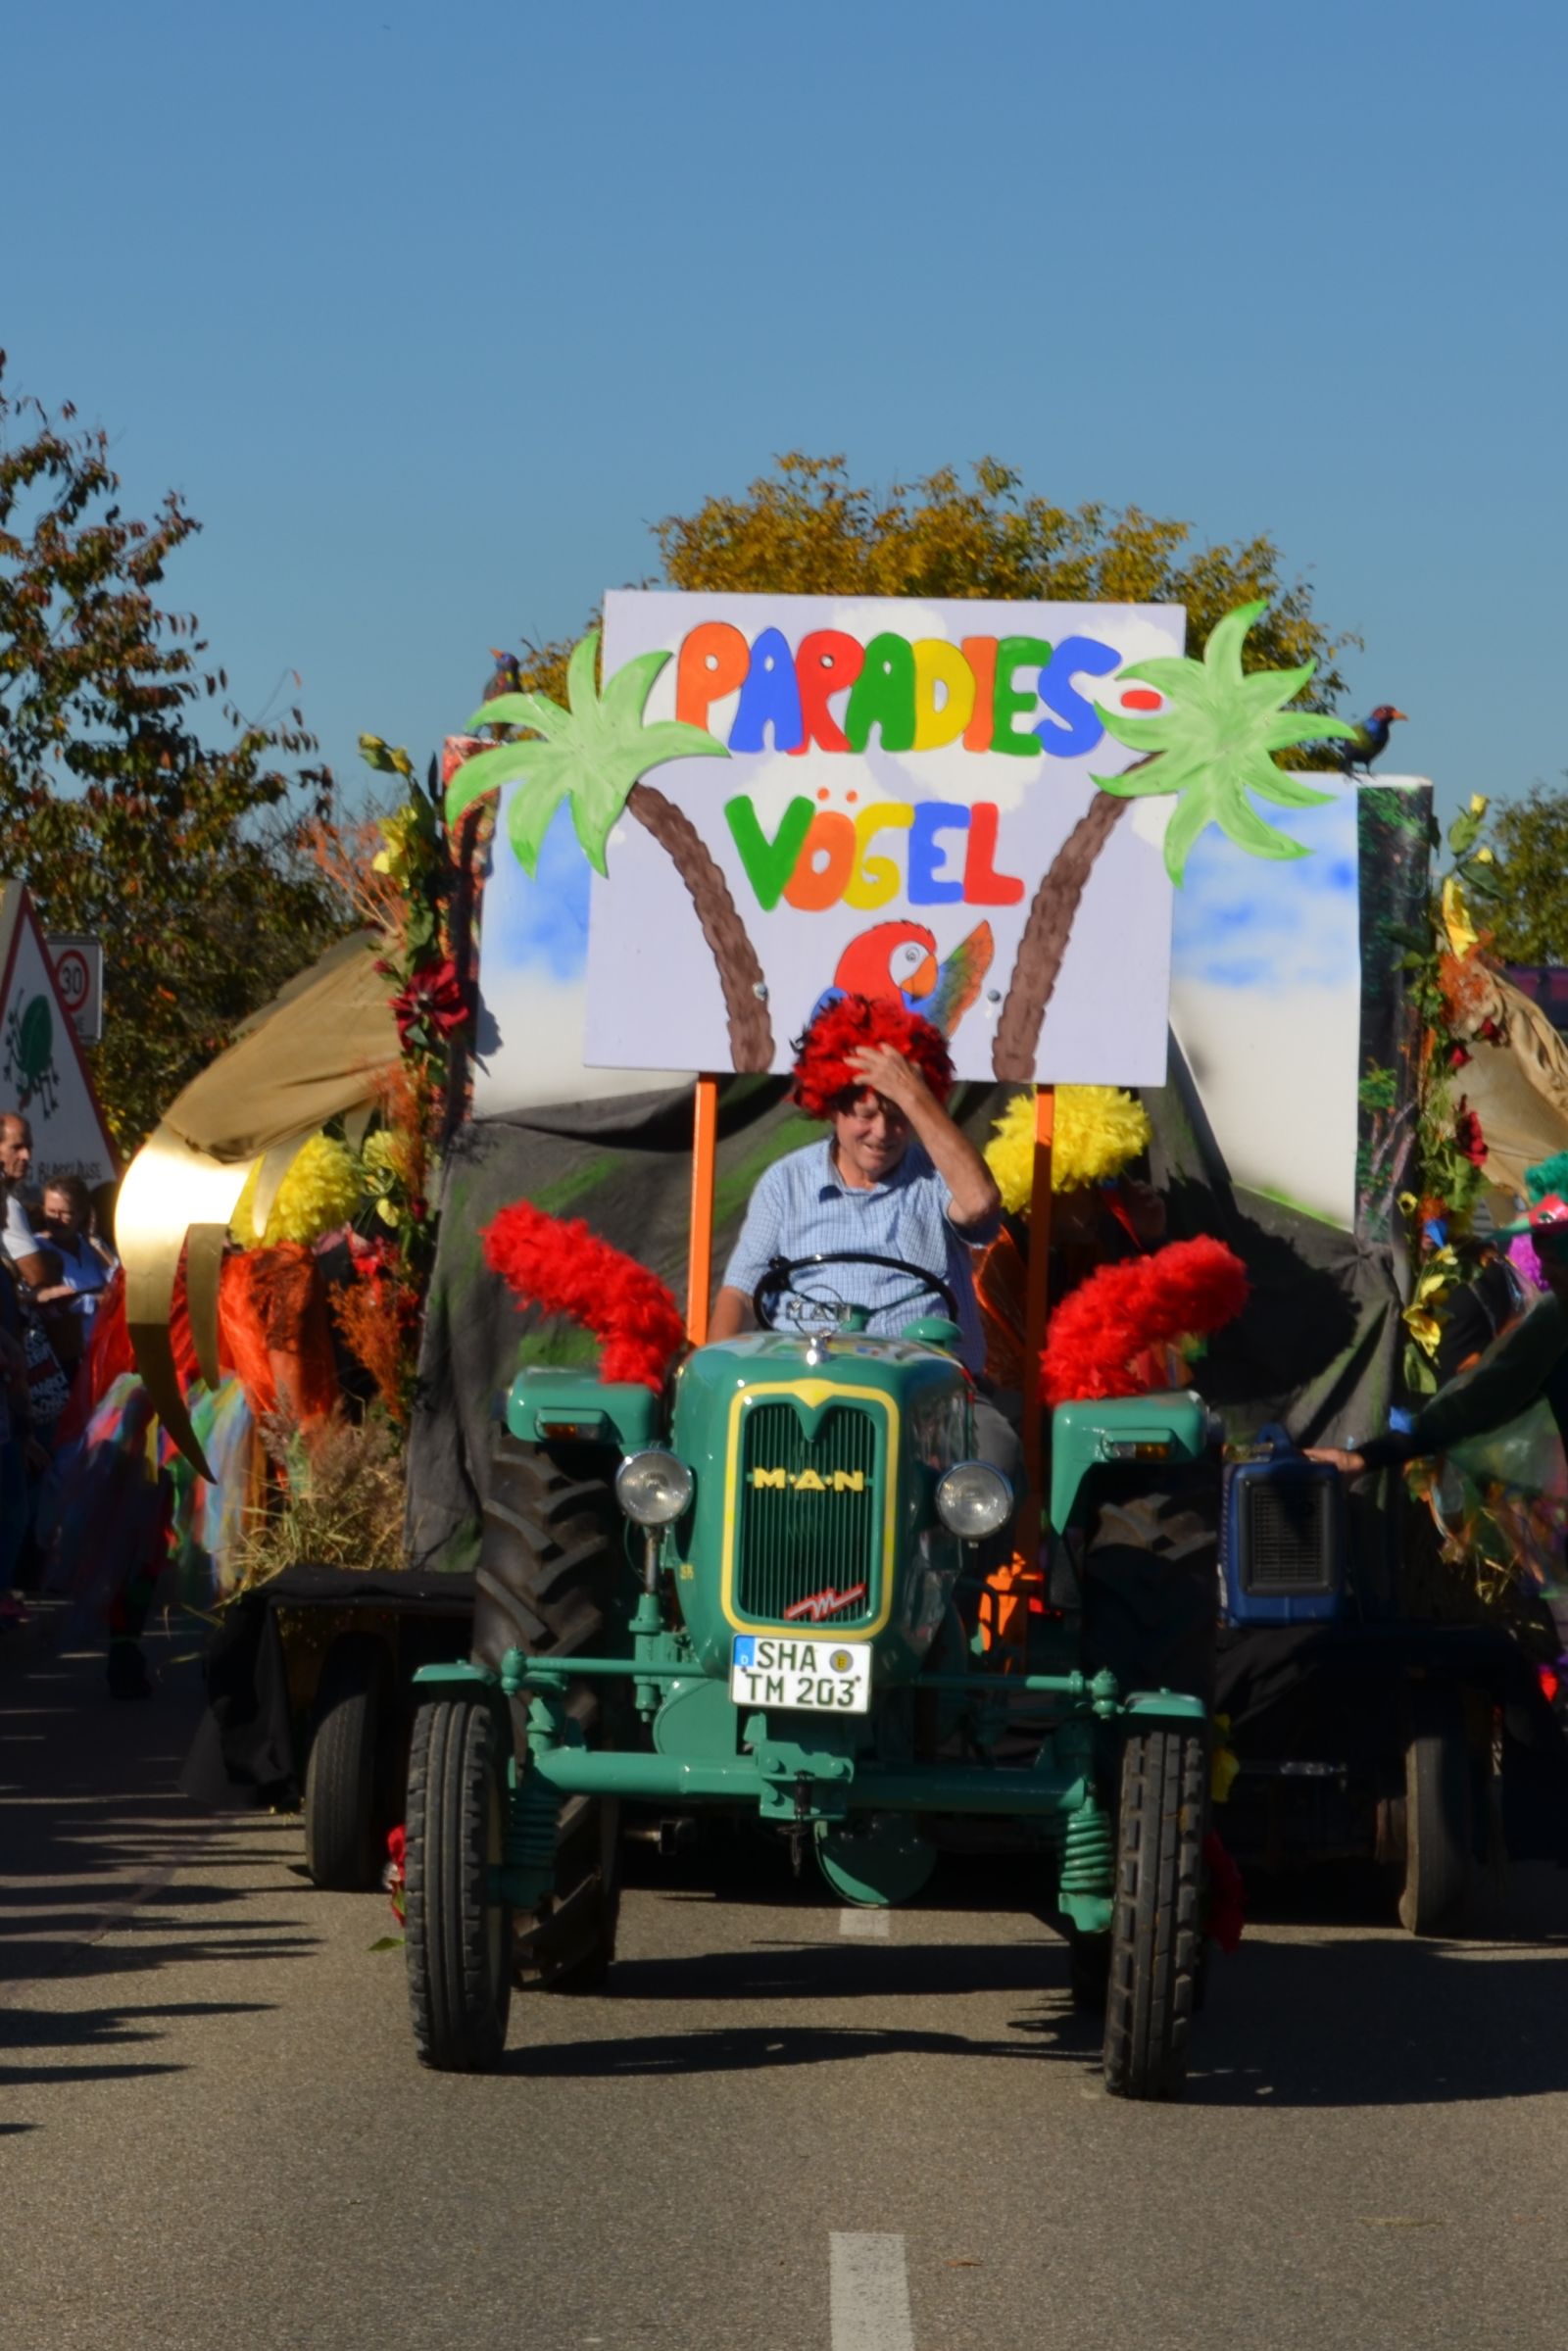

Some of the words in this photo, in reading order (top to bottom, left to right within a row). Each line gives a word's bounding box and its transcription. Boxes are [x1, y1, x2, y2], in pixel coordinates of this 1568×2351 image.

[723, 787, 1025, 911] VÖGEL
[62, 966, 82, 995] 30
[757, 1641, 816, 1673] SHA
[746, 1673, 784, 1703] TM
[796, 1677, 855, 1706] 203
